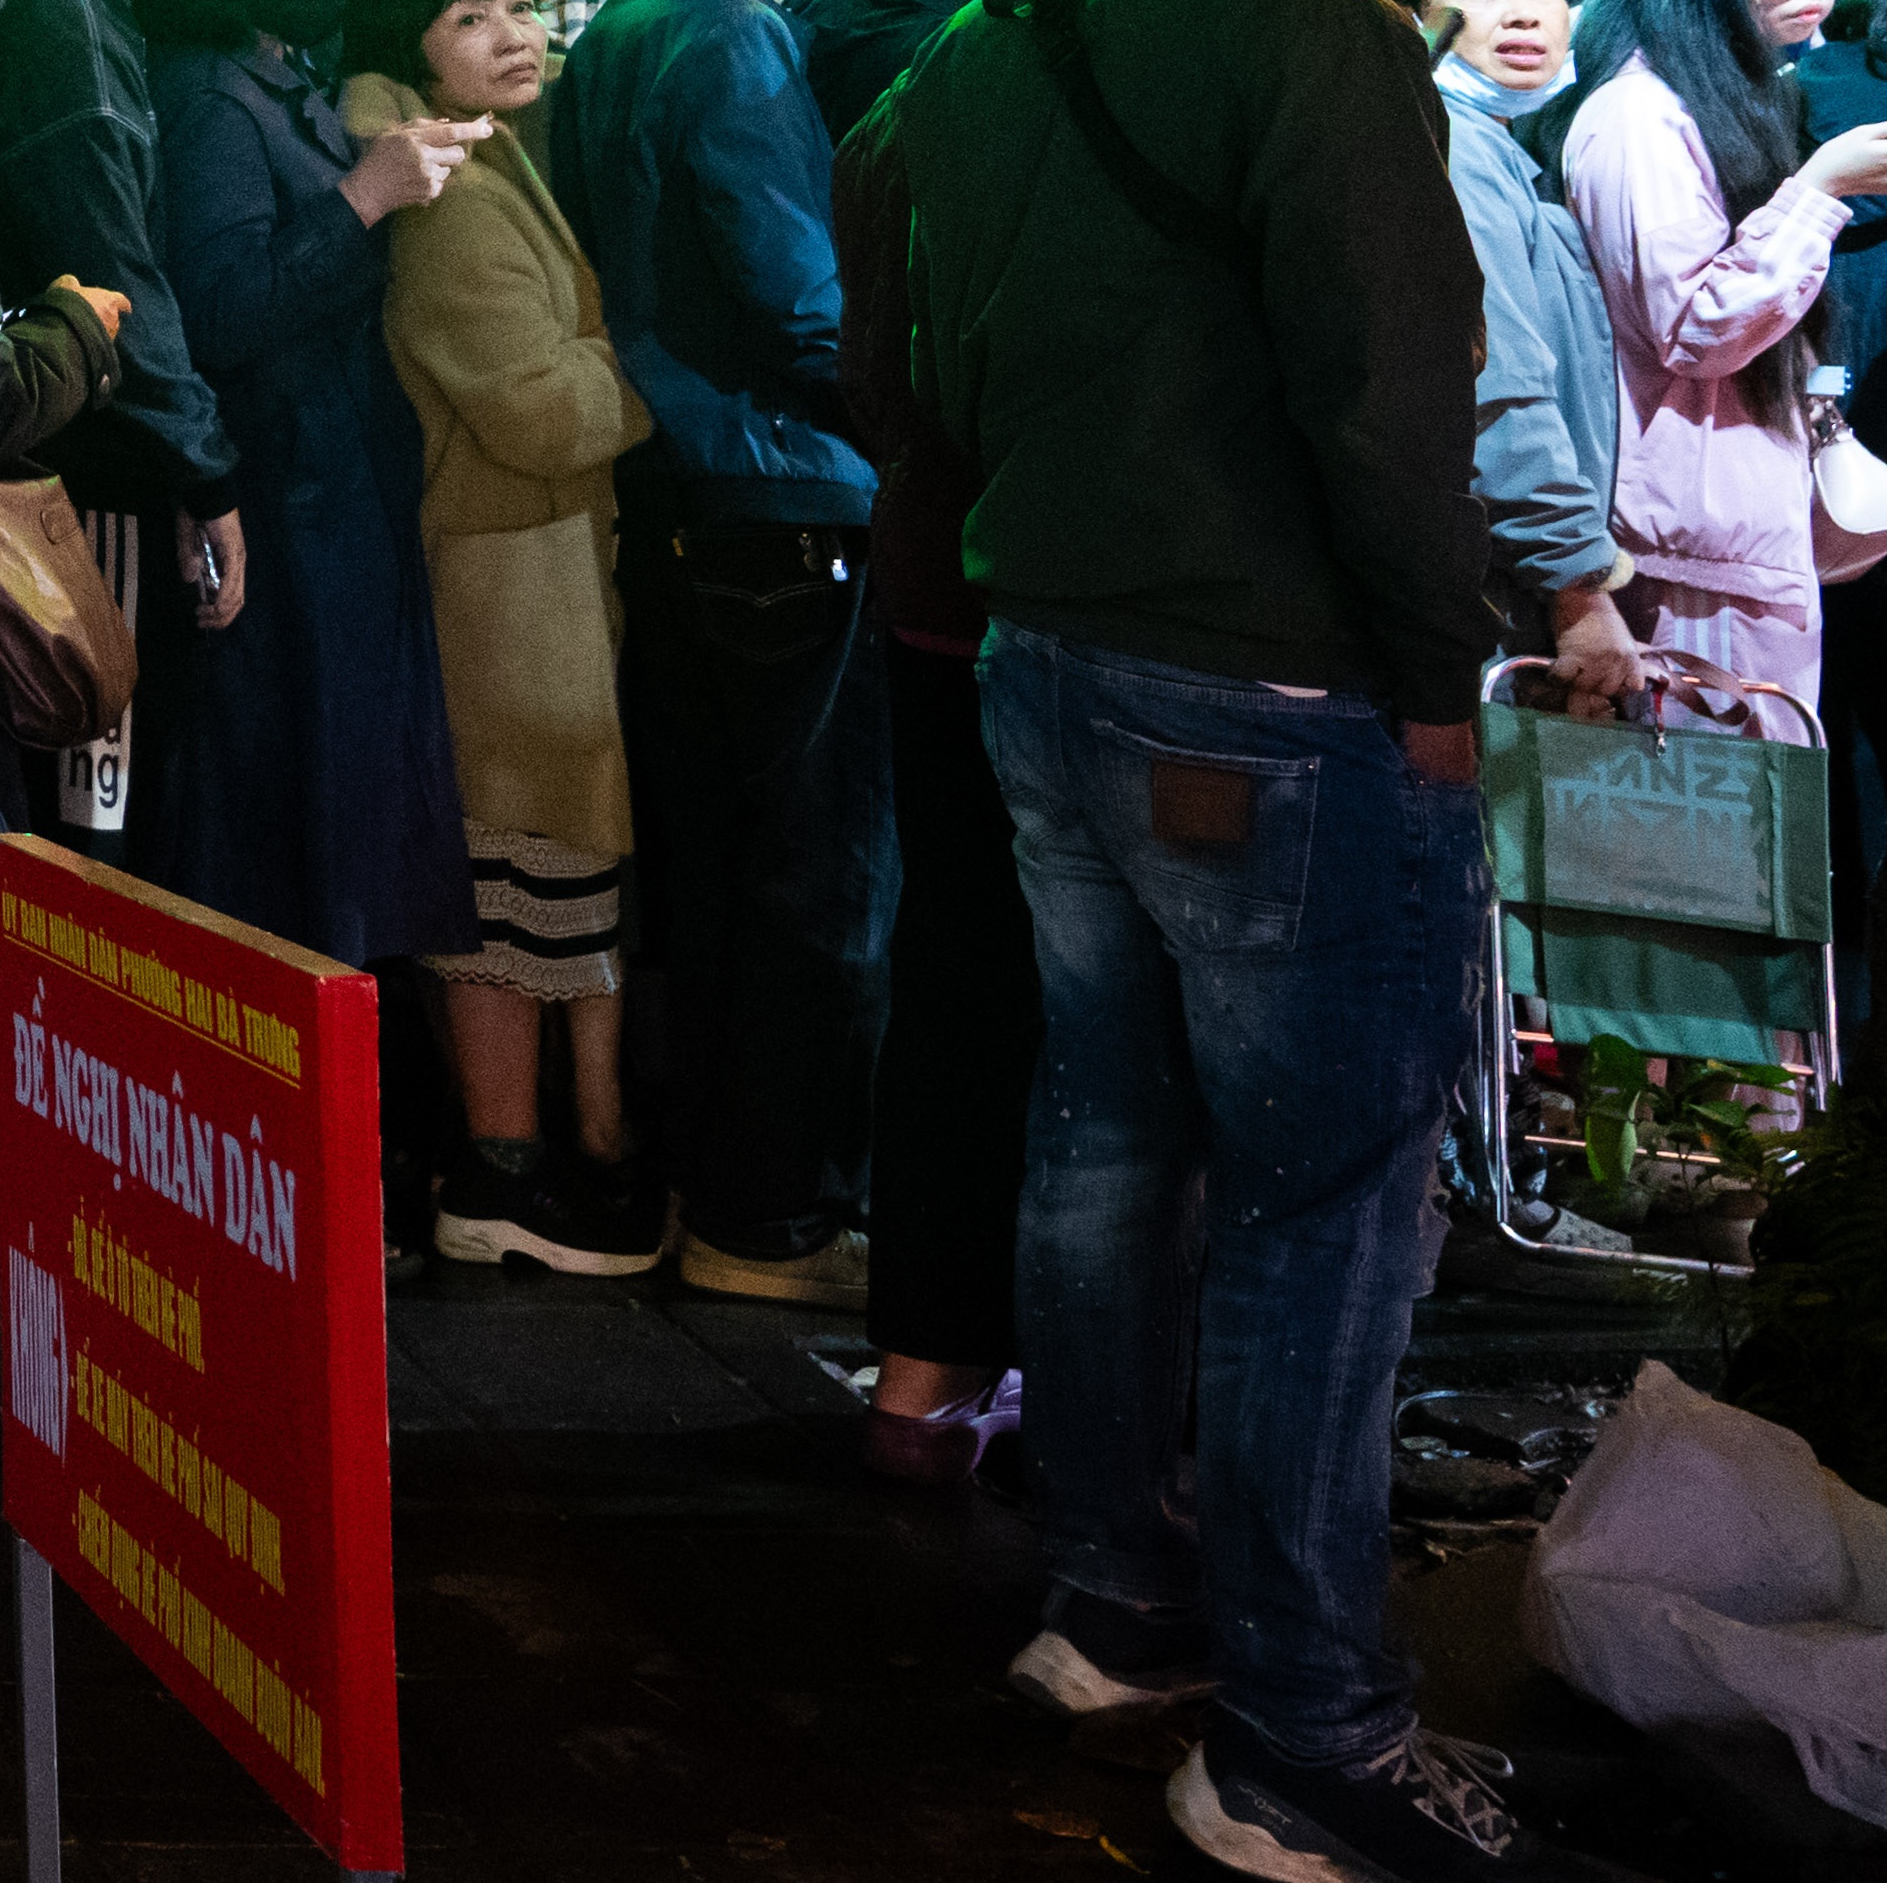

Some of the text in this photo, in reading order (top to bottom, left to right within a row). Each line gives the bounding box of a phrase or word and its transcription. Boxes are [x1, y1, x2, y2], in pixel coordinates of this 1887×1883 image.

[89, 928, 118, 984] DÂN
[185, 978, 213, 1033] HAI
[14, 978, 295, 1279] ĐỀ NGHỊ NHÂN DÂN
